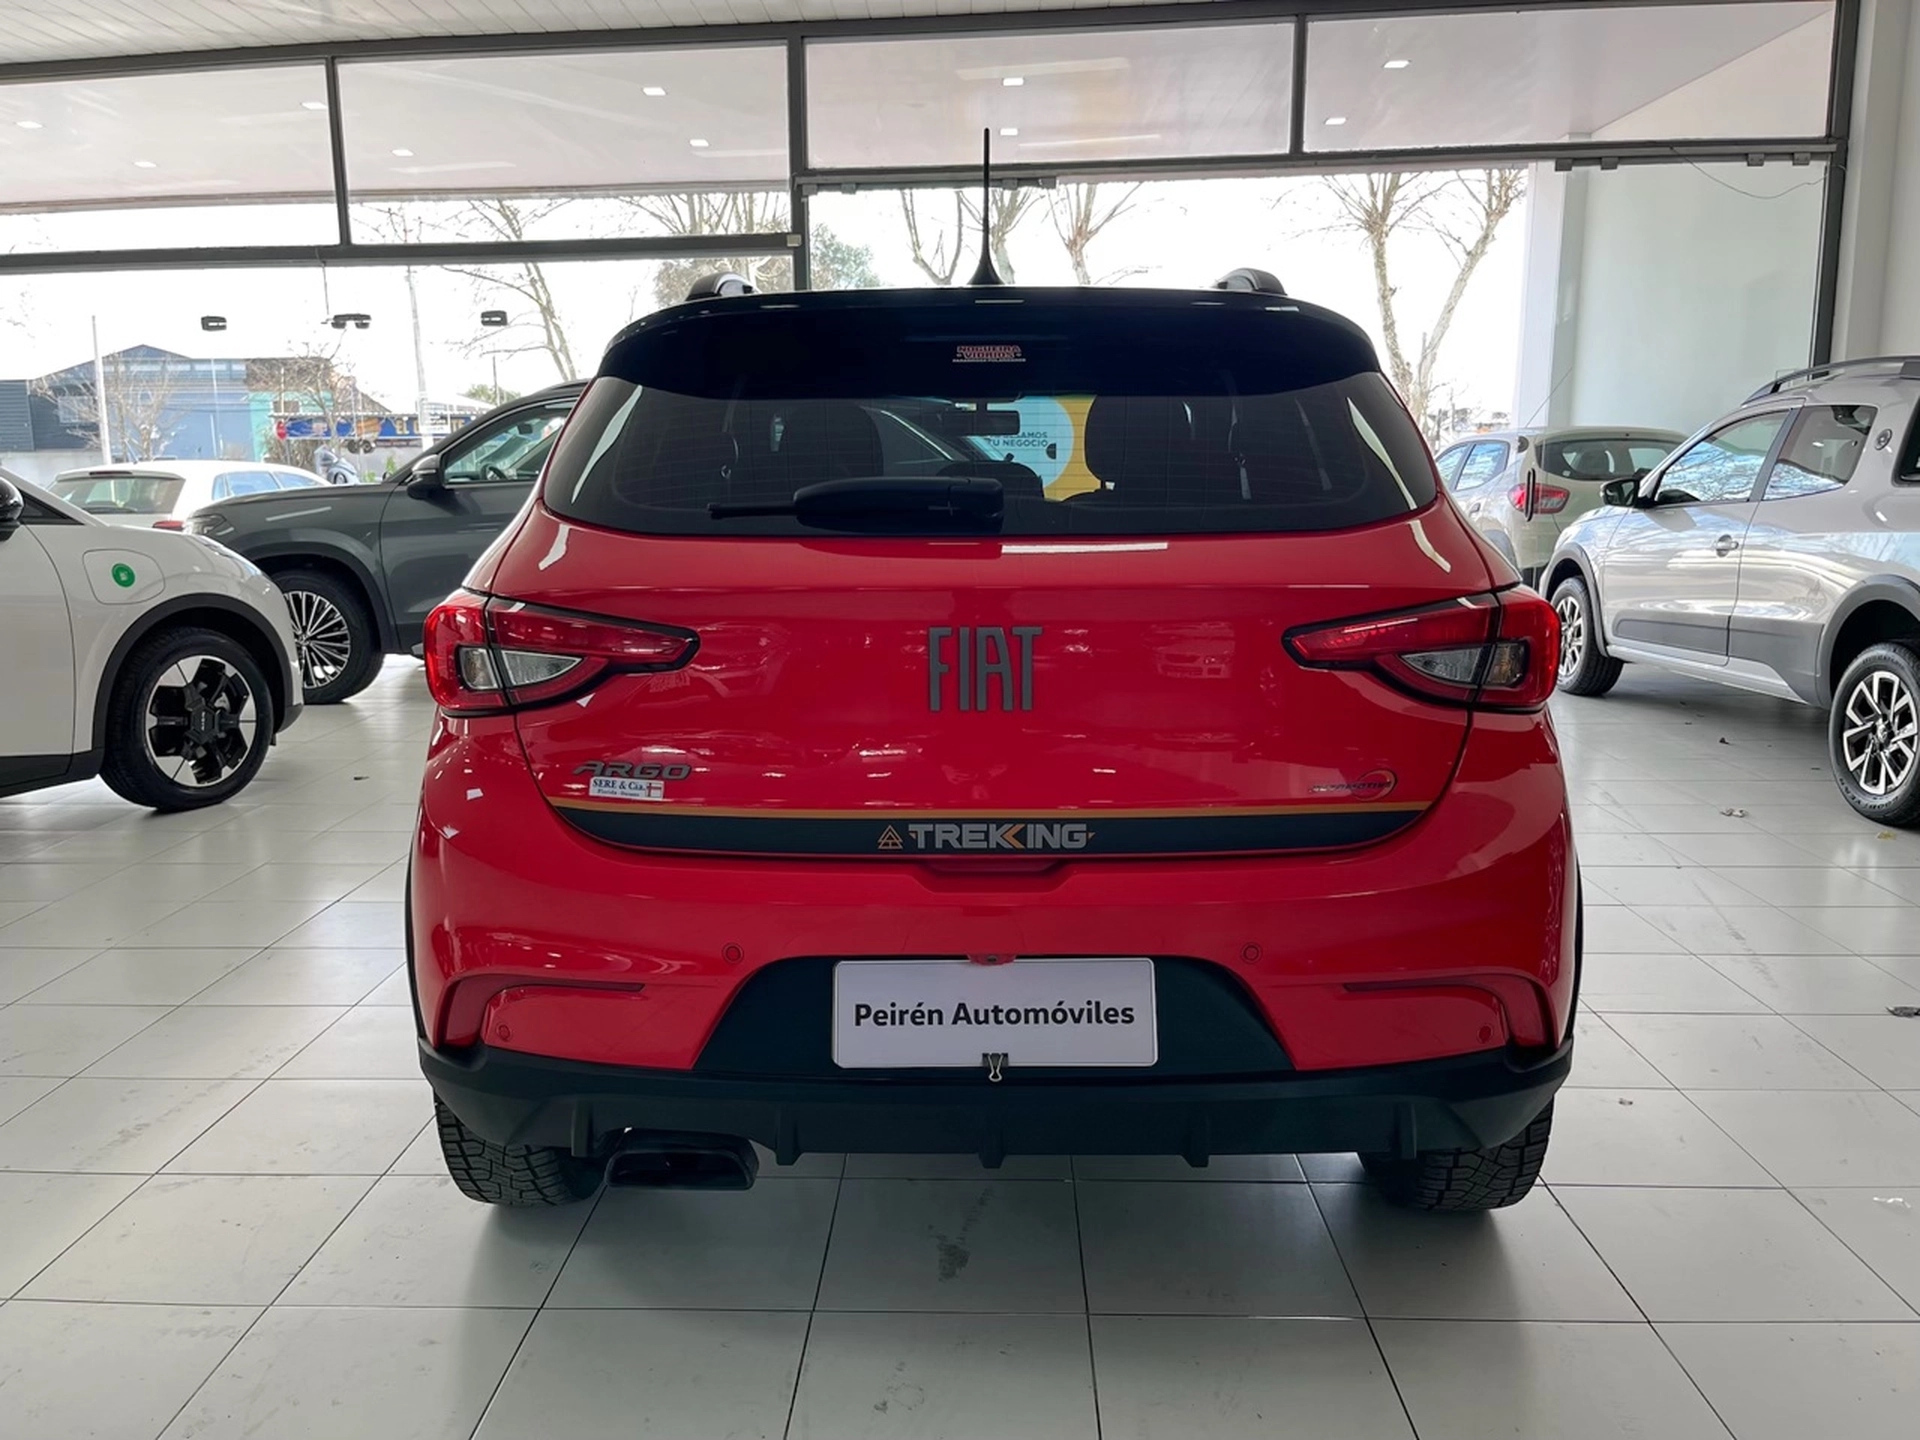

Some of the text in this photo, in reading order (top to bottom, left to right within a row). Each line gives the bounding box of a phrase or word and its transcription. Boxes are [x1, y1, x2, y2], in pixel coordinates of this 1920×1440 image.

[1002, 439, 1048, 447] NEGOCIO
[928, 626, 1043, 711] FIAT
[572, 760, 692, 780] ARGO
[908, 823, 1090, 849] TREKKING
[854, 1000, 1135, 1027] Peirén Automóviles
